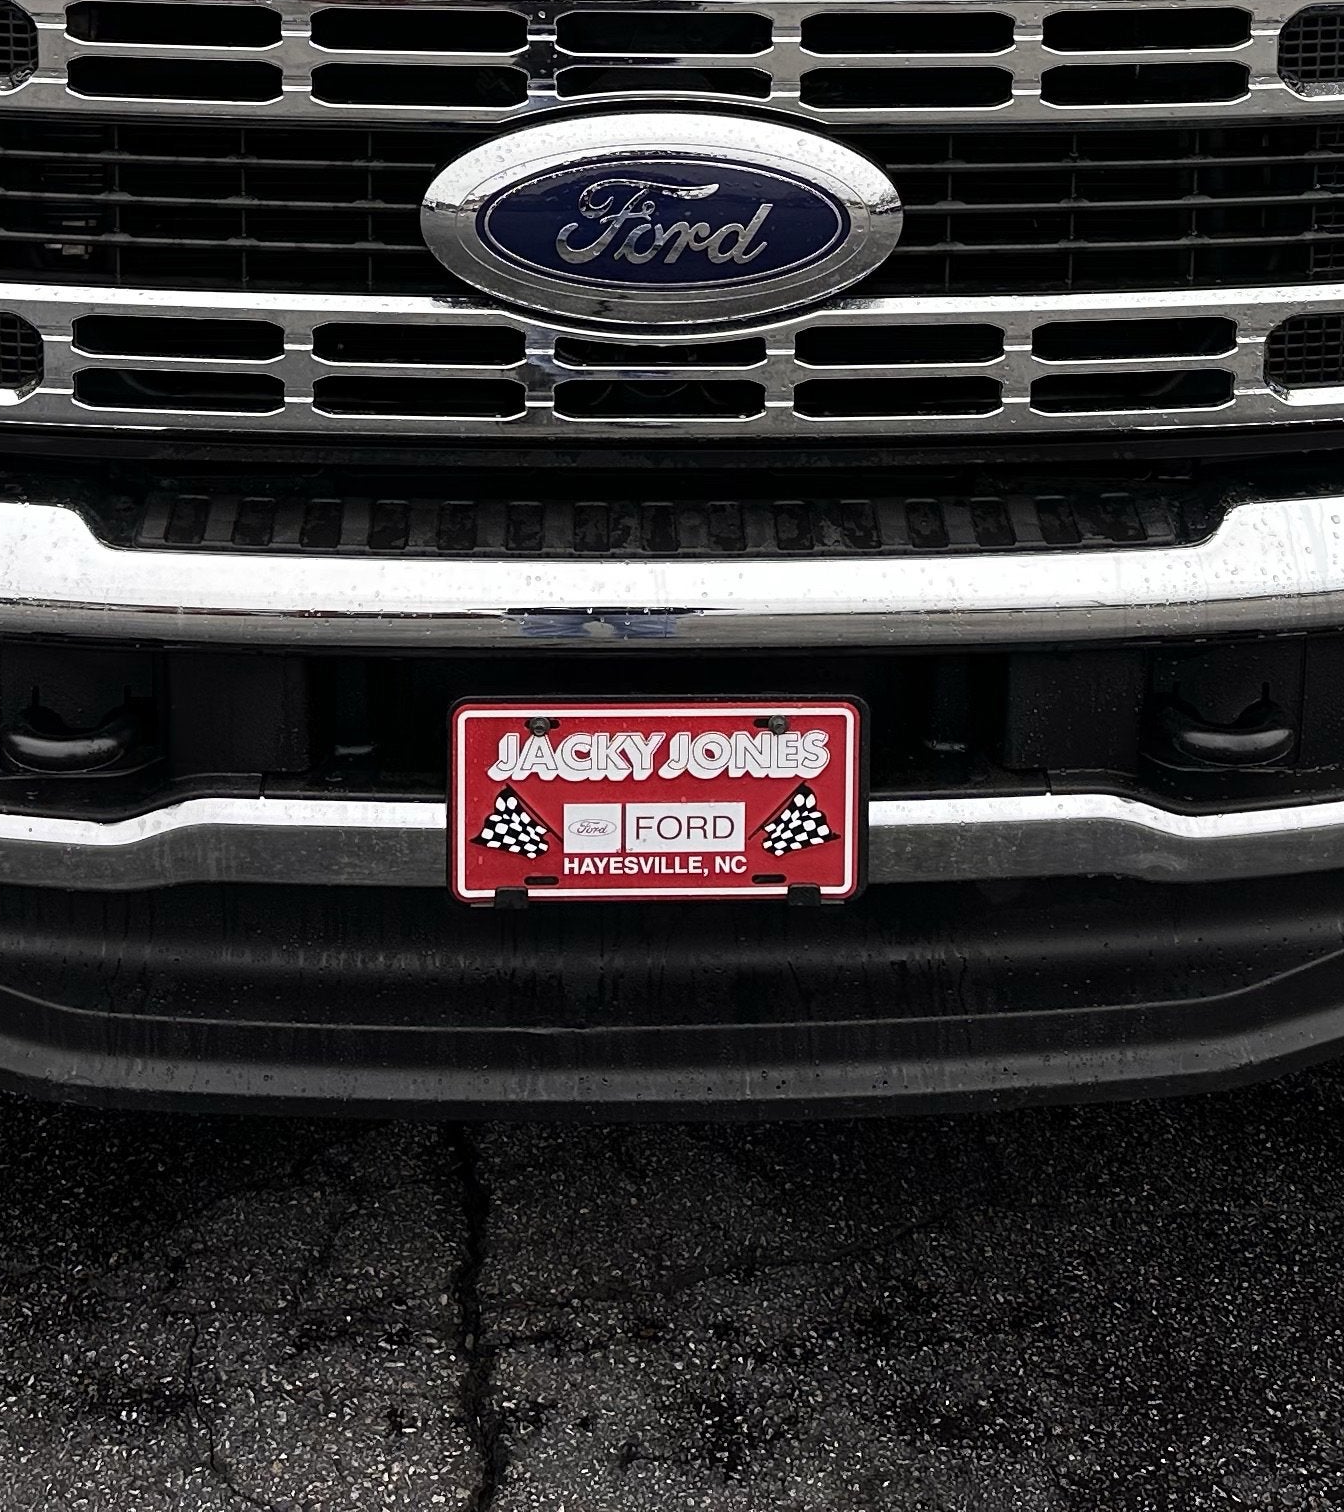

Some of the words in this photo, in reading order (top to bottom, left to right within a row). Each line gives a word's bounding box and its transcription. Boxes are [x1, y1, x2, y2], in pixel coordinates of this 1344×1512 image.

[556, 178, 774, 265] Ford
[487, 730, 666, 782] JACKY
[657, 729, 831, 780] JONES
[576, 820, 609, 834] Ford
[635, 815, 735, 840] FORD
[563, 856, 709, 877] HAYESVILLE,
[714, 855, 747, 874] NC
